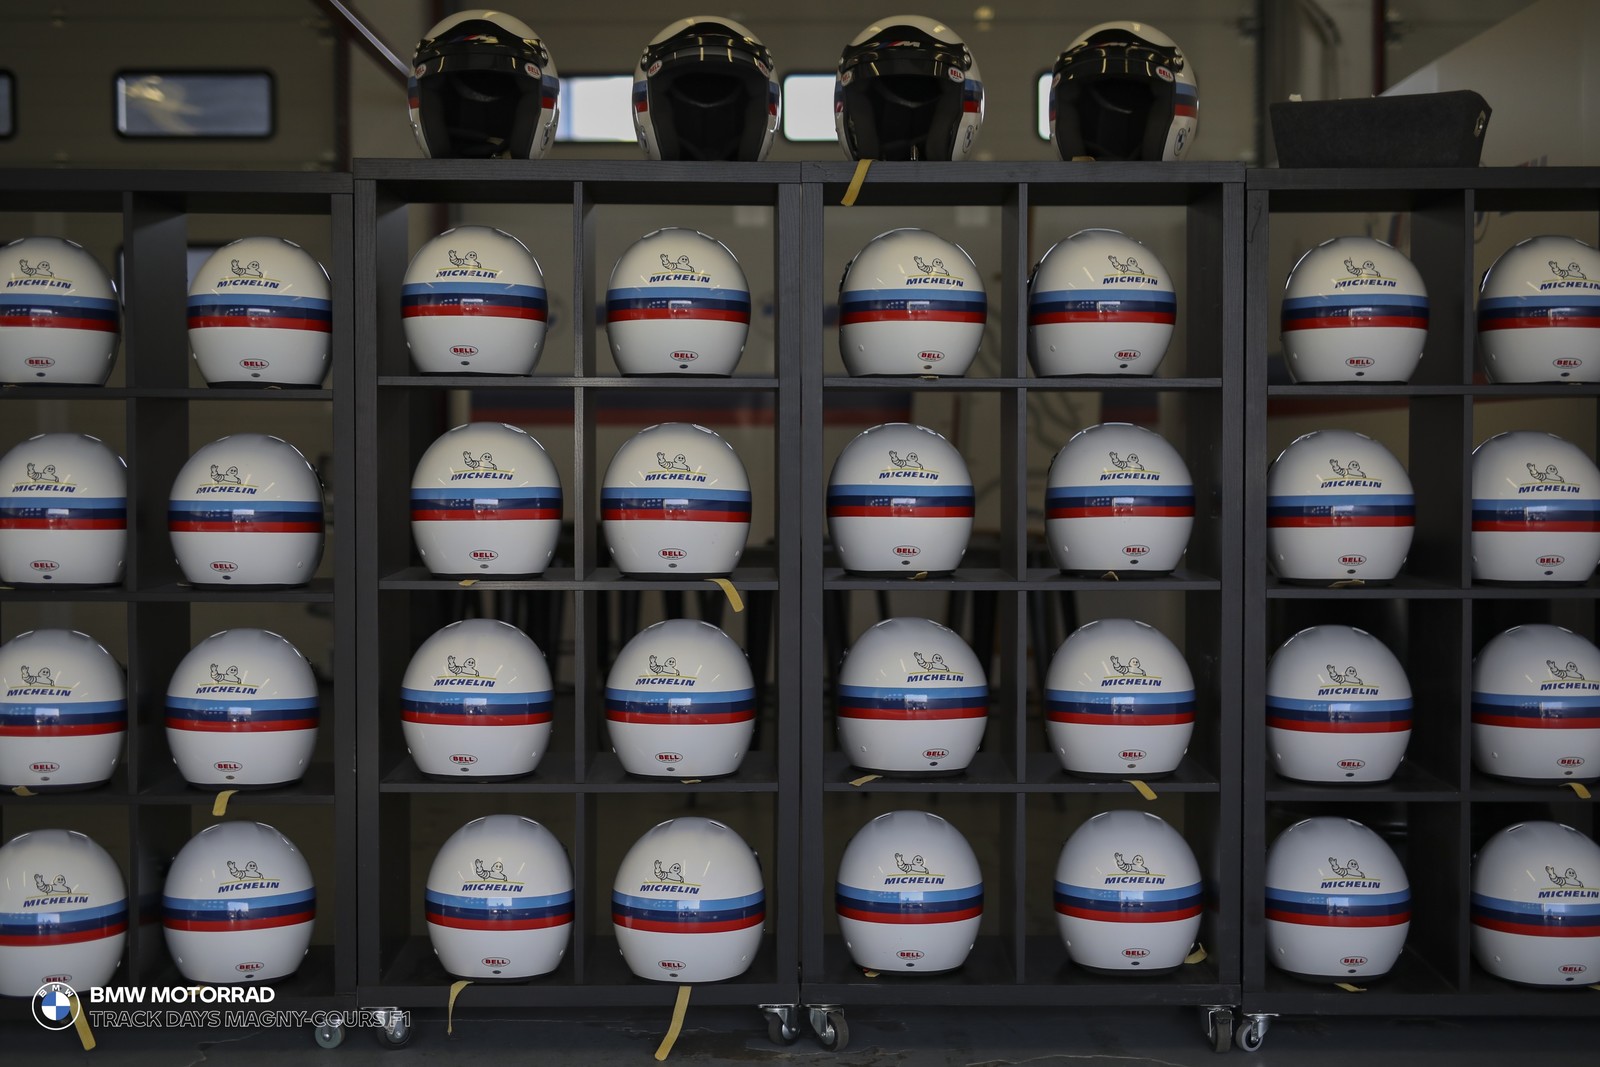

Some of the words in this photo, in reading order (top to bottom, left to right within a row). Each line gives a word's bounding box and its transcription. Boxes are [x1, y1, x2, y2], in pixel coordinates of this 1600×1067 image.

[527, 65, 540, 76] BELL
[649, 63, 660, 74] BELL
[950, 69, 962, 79] BELL
[1158, 68, 1172, 79] BELL
[436, 269, 497, 279] MICHELIN
[649, 274, 710, 283] MICHELIN
[7, 280, 72, 289] MICHELIN
[217, 279, 279, 289] MICHELIN
[906, 277, 964, 287] MICHELIN
[1103, 276, 1158, 285] MICHELIN
[1335, 279, 1396, 288] MICHELIN
[1540, 281, 1600, 290] MICHELIN
[451, 472, 513, 481] MICHELIN
[645, 474, 706, 483] MICHELIN
[879, 472, 939, 480] MICHELIN
[1100, 473, 1160, 481] MICHELIN
[12, 484, 76, 493] MICHELIN
[1321, 480, 1382, 489] MICHELIN
[1518, 485, 1580, 493] MICHELIN
[196, 486, 257, 495] MICHELIN
[433, 679, 495, 688] MICHELIN
[636, 678, 696, 687] MICHELIN
[906, 675, 964, 683] MICHELIN
[1101, 679, 1161, 687] MICHELIN
[196, 687, 257, 695] MICHELIN
[1540, 683, 1600, 691] MICHELIN
[6, 688, 71, 697] MICHELIN
[1317, 688, 1379, 696] MICHELIN
[1105, 877, 1165, 885] MICHELIN
[1320, 881, 1380, 889] MICHELIN
[218, 882, 279, 893] MICHELIN
[462, 884, 523, 892] MICHELIN
[640, 884, 700, 894] MICHELIN
[1538, 890, 1599, 898] MICHELIN
[23, 897, 88, 907] MICHELIN
